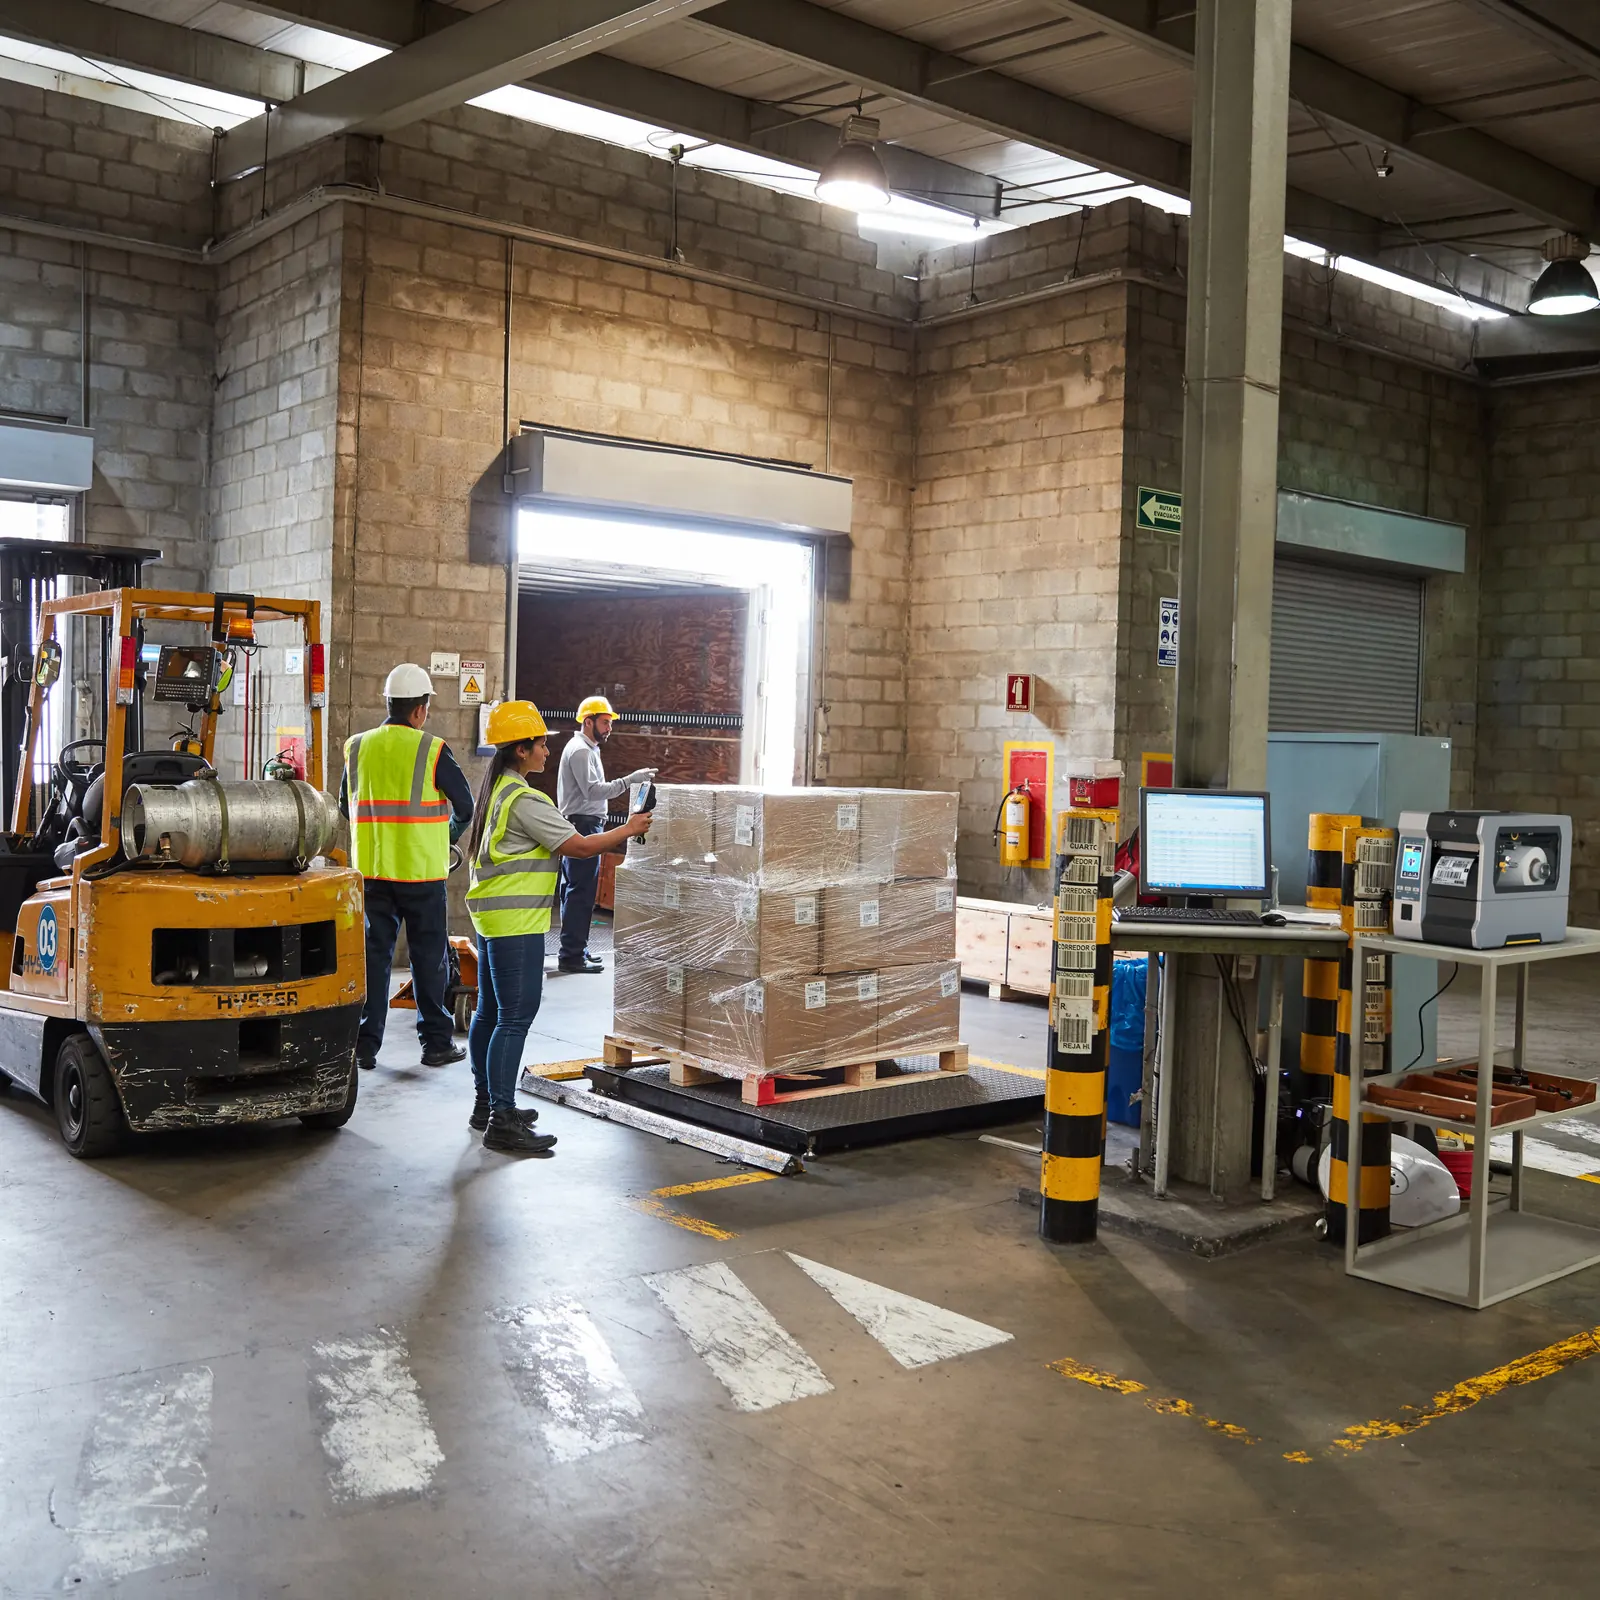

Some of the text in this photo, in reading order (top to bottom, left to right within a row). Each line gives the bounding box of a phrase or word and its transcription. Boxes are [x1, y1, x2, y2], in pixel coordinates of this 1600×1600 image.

[1059, 916, 1090, 924] CORREDOR
[40, 918, 56, 956] 03
[1058, 943, 1090, 951] CORREDOR
